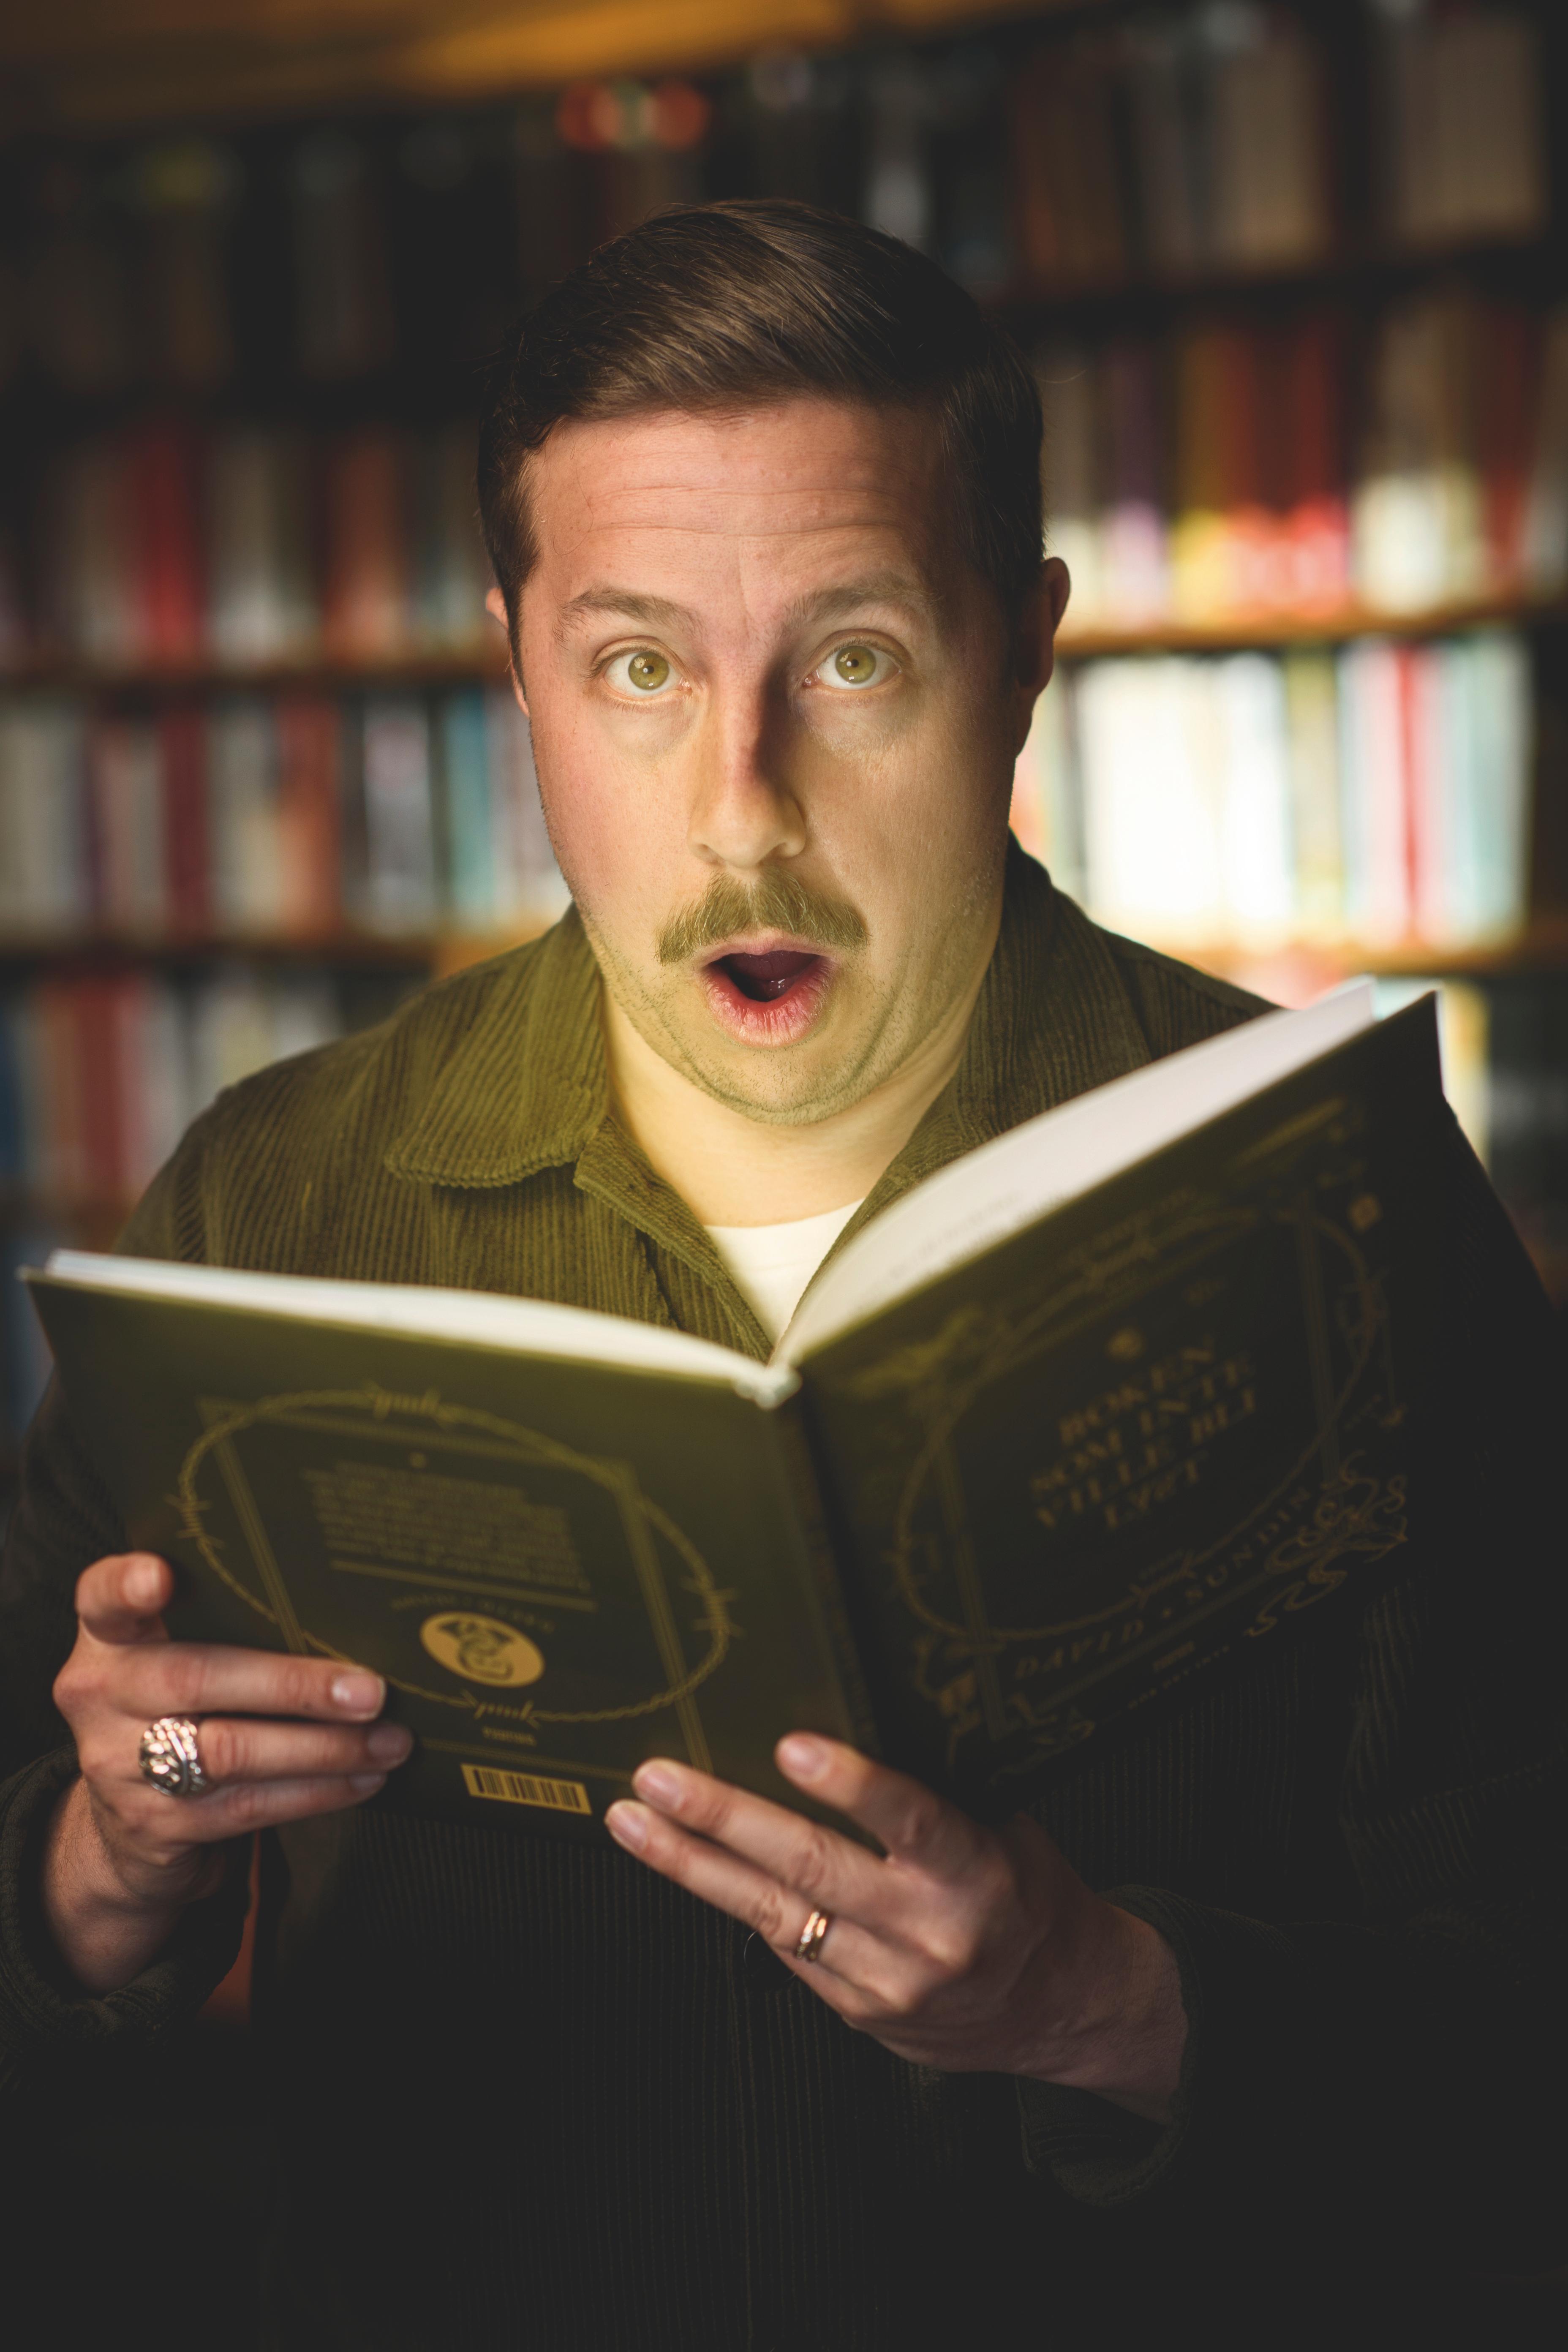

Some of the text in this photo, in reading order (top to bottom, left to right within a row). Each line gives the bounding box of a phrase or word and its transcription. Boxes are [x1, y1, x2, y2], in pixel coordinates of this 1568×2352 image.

[1027, 1425, 1124, 1504] SOM
[1135, 1348, 1258, 1437] INTE
[1032, 1435, 1177, 1531] VILLE
[1187, 1381, 1258, 1446] BLI
[1057, 1331, 1217, 1448] BOKEN
[1012, 1484, 1313, 1682] DAVID SUNDIN
